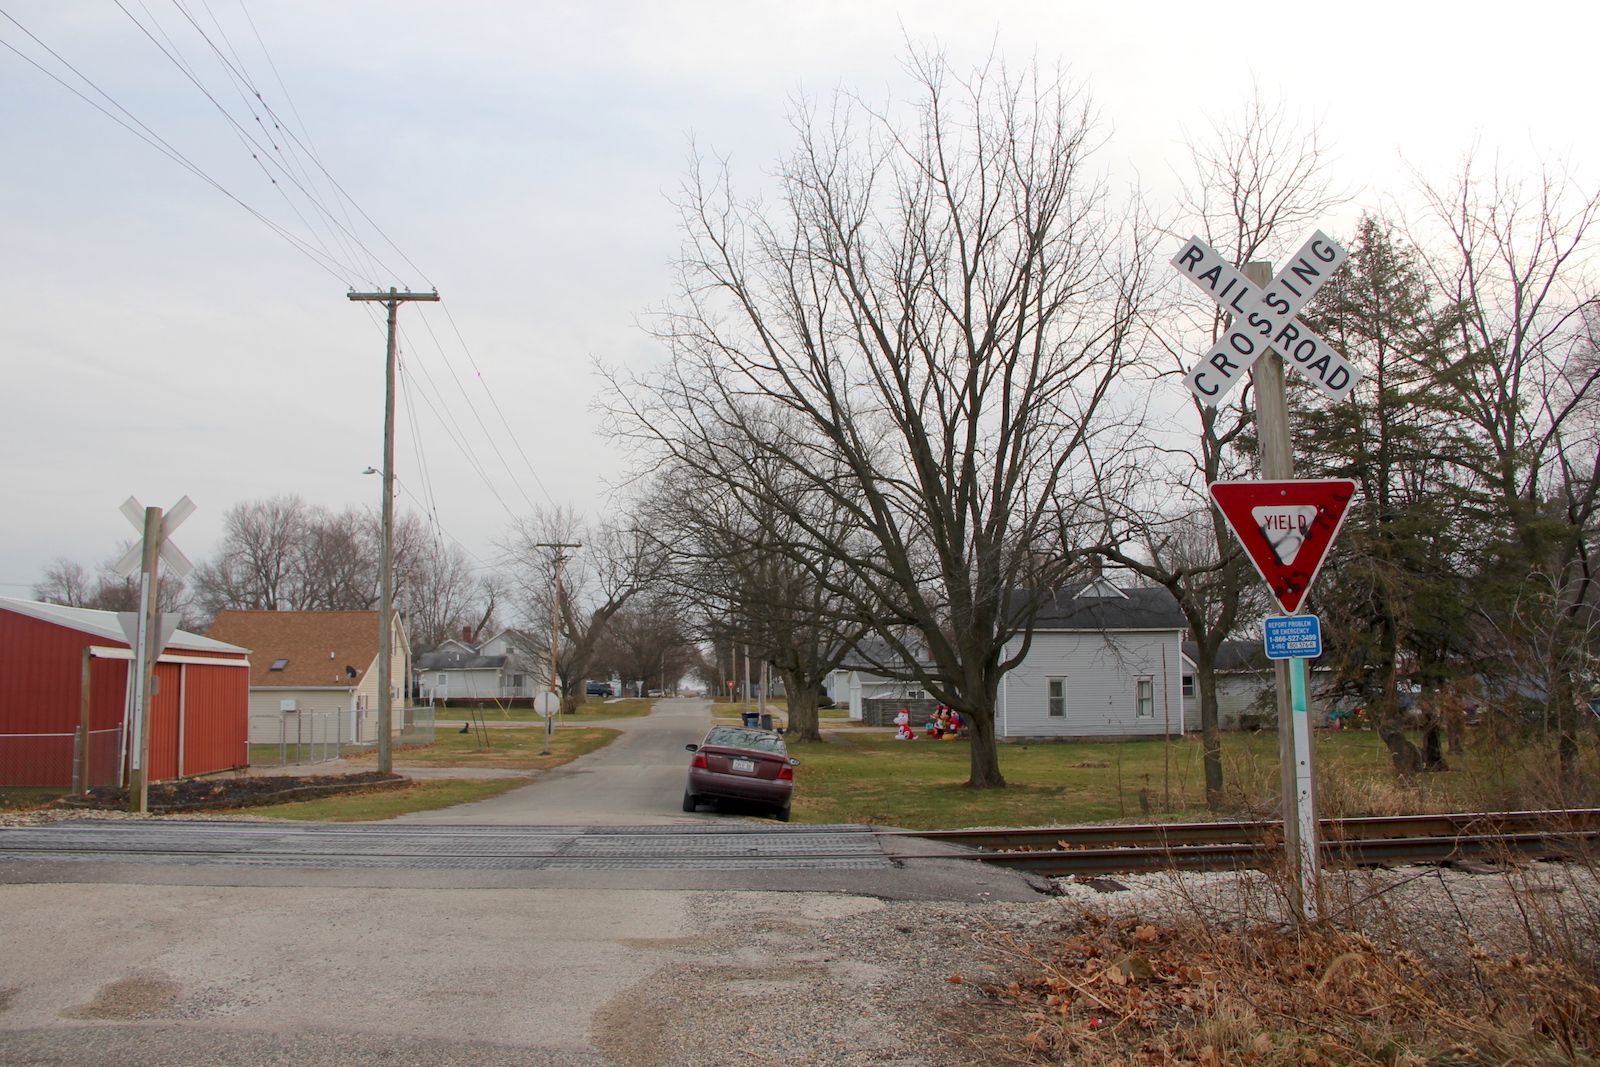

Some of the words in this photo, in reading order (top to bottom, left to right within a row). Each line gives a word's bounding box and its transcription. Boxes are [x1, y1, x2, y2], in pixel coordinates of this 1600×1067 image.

[1194, 240, 1335, 396] CROSSING
[1264, 514, 1307, 530] YIELD
[1269, 634, 1317, 643] 1-866-527-3499
